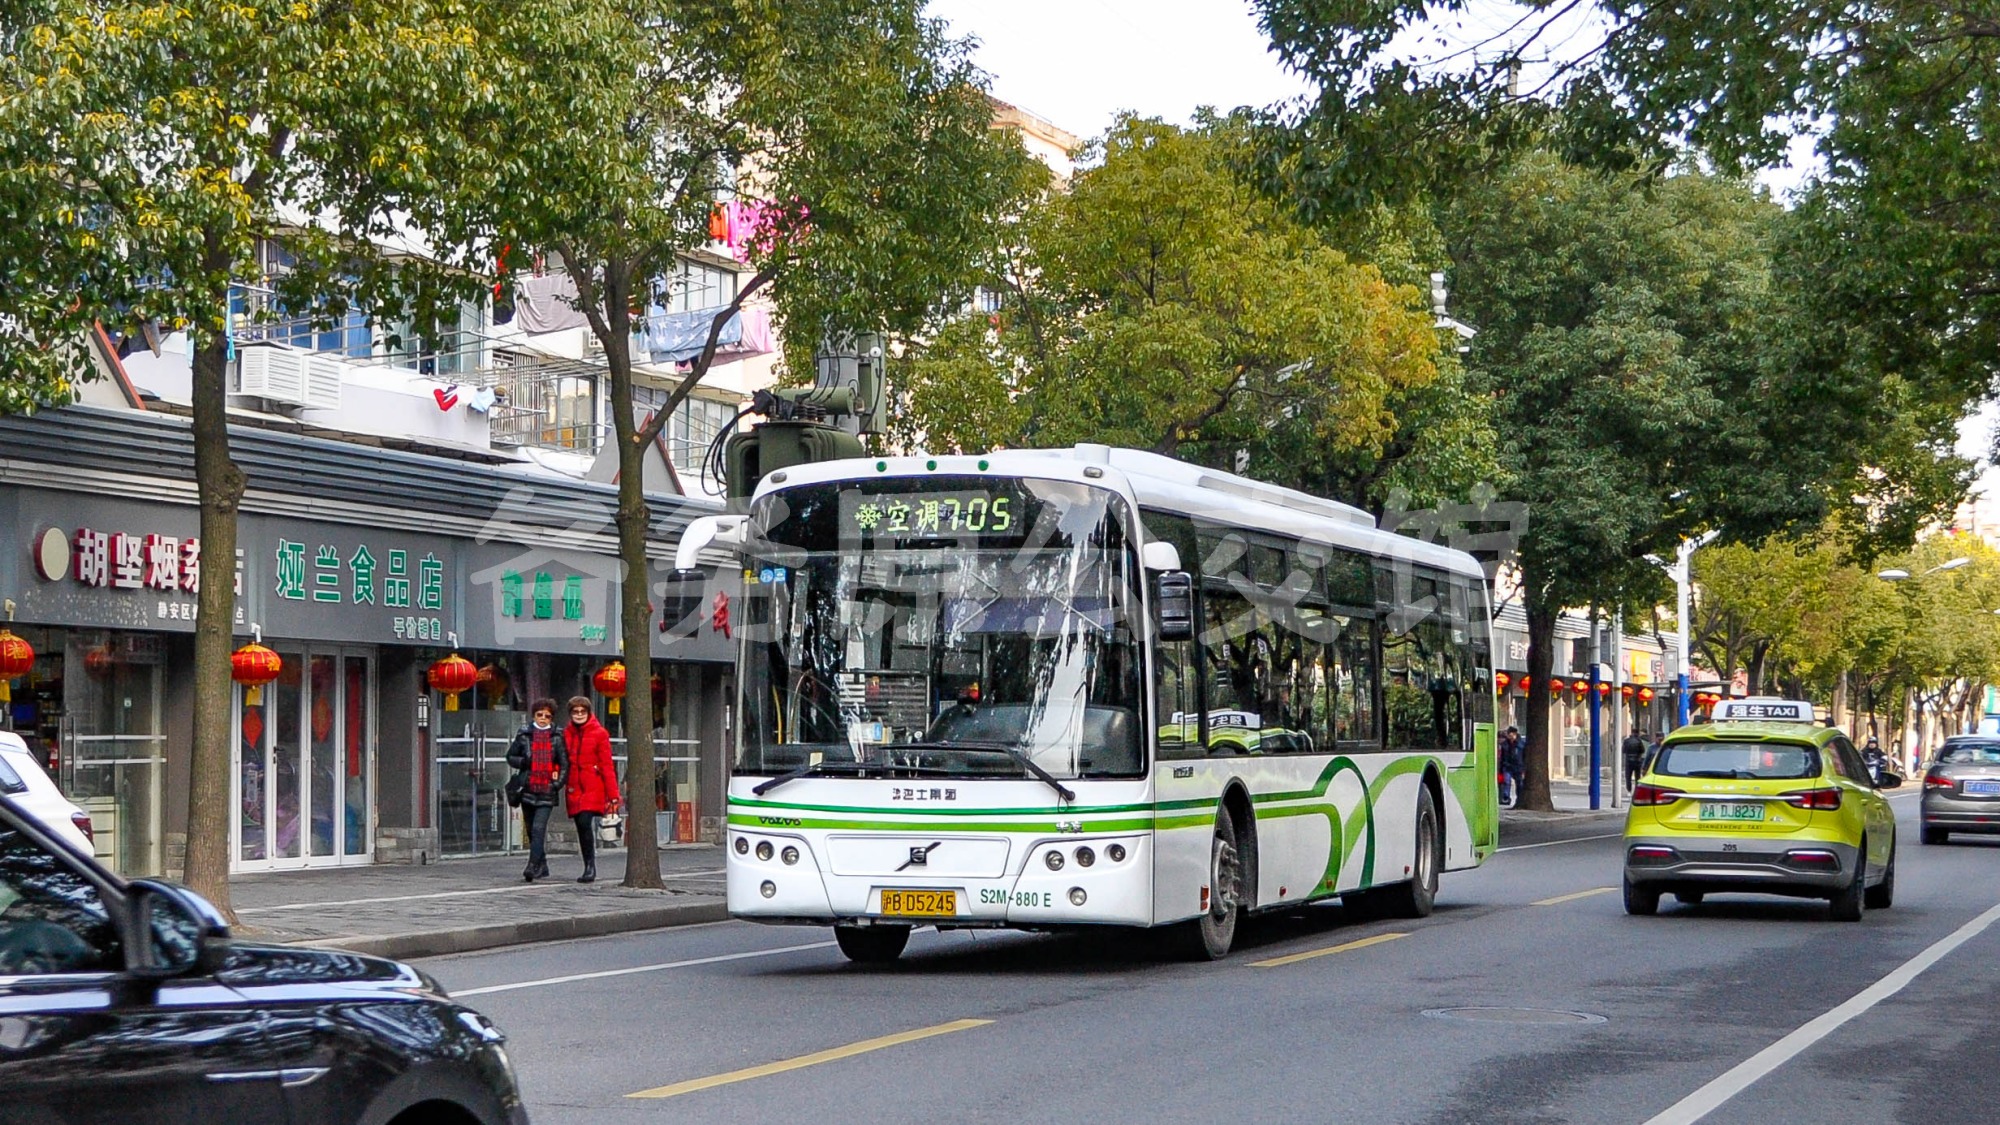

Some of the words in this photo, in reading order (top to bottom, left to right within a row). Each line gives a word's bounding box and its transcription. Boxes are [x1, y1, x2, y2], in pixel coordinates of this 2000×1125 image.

[275, 538, 443, 610] 娅兰食品店
[759, 816, 801, 826] VOLVO
[1043, 893, 1052, 907] E
